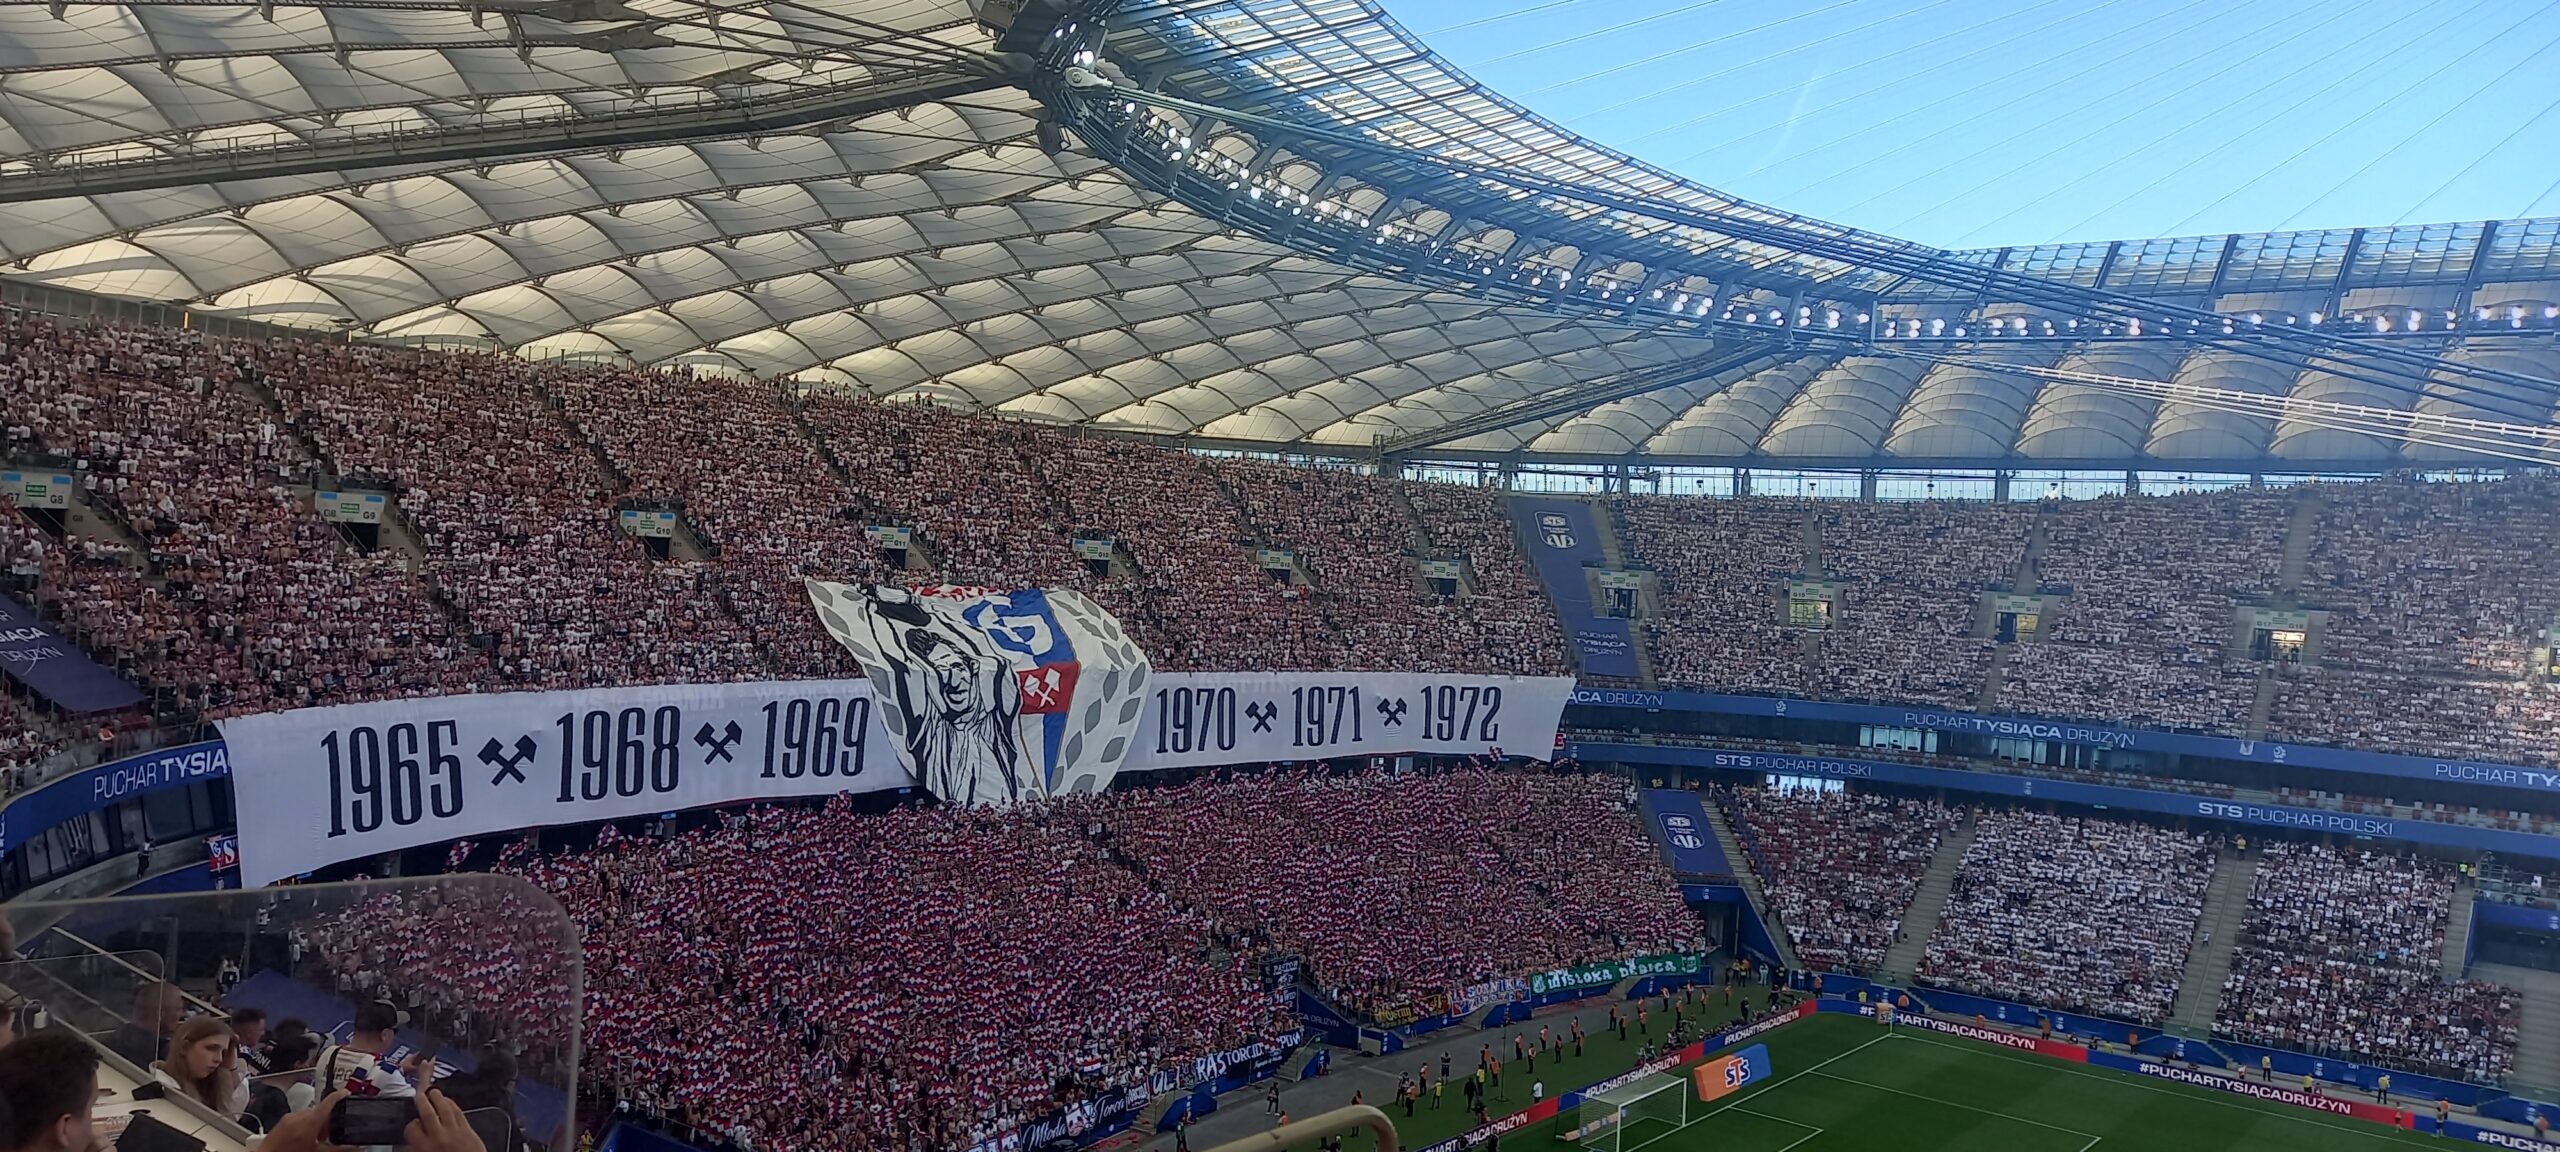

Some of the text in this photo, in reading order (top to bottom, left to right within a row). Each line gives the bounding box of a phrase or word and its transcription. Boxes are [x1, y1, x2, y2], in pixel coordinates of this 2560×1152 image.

[50, 494, 64, 505] G8
[323, 508, 337, 518] G8
[363, 511, 376, 520] G9
[656, 527, 671, 535] G10
[1579, 630, 1618, 640] PUCHAR
[1606, 691, 1663, 706] DRUŻYN
[1905, 712, 2136, 746] PUCHAR TYSIĄCA DRUŻYN
[320, 685, 1502, 838] 1965 1968 1969 1970 1971 1972
[1715, 753, 1872, 777] STS PUCHAR POLSKI
[94, 762, 157, 802] PUCHAR
[2435, 763, 2560, 788] PUCHAR TY
[2198, 802, 2394, 836] STS PUCHAR POLSKI
[1858, 1005, 2036, 1051] #PHARTYSIĄCADRUŻYN
[1225, 1042, 1265, 1066] TORCID
[1725, 1056, 1752, 1089] STS
[2139, 1062, 2351, 1115] #PUCHARTYSIĄCADRUŻYN
